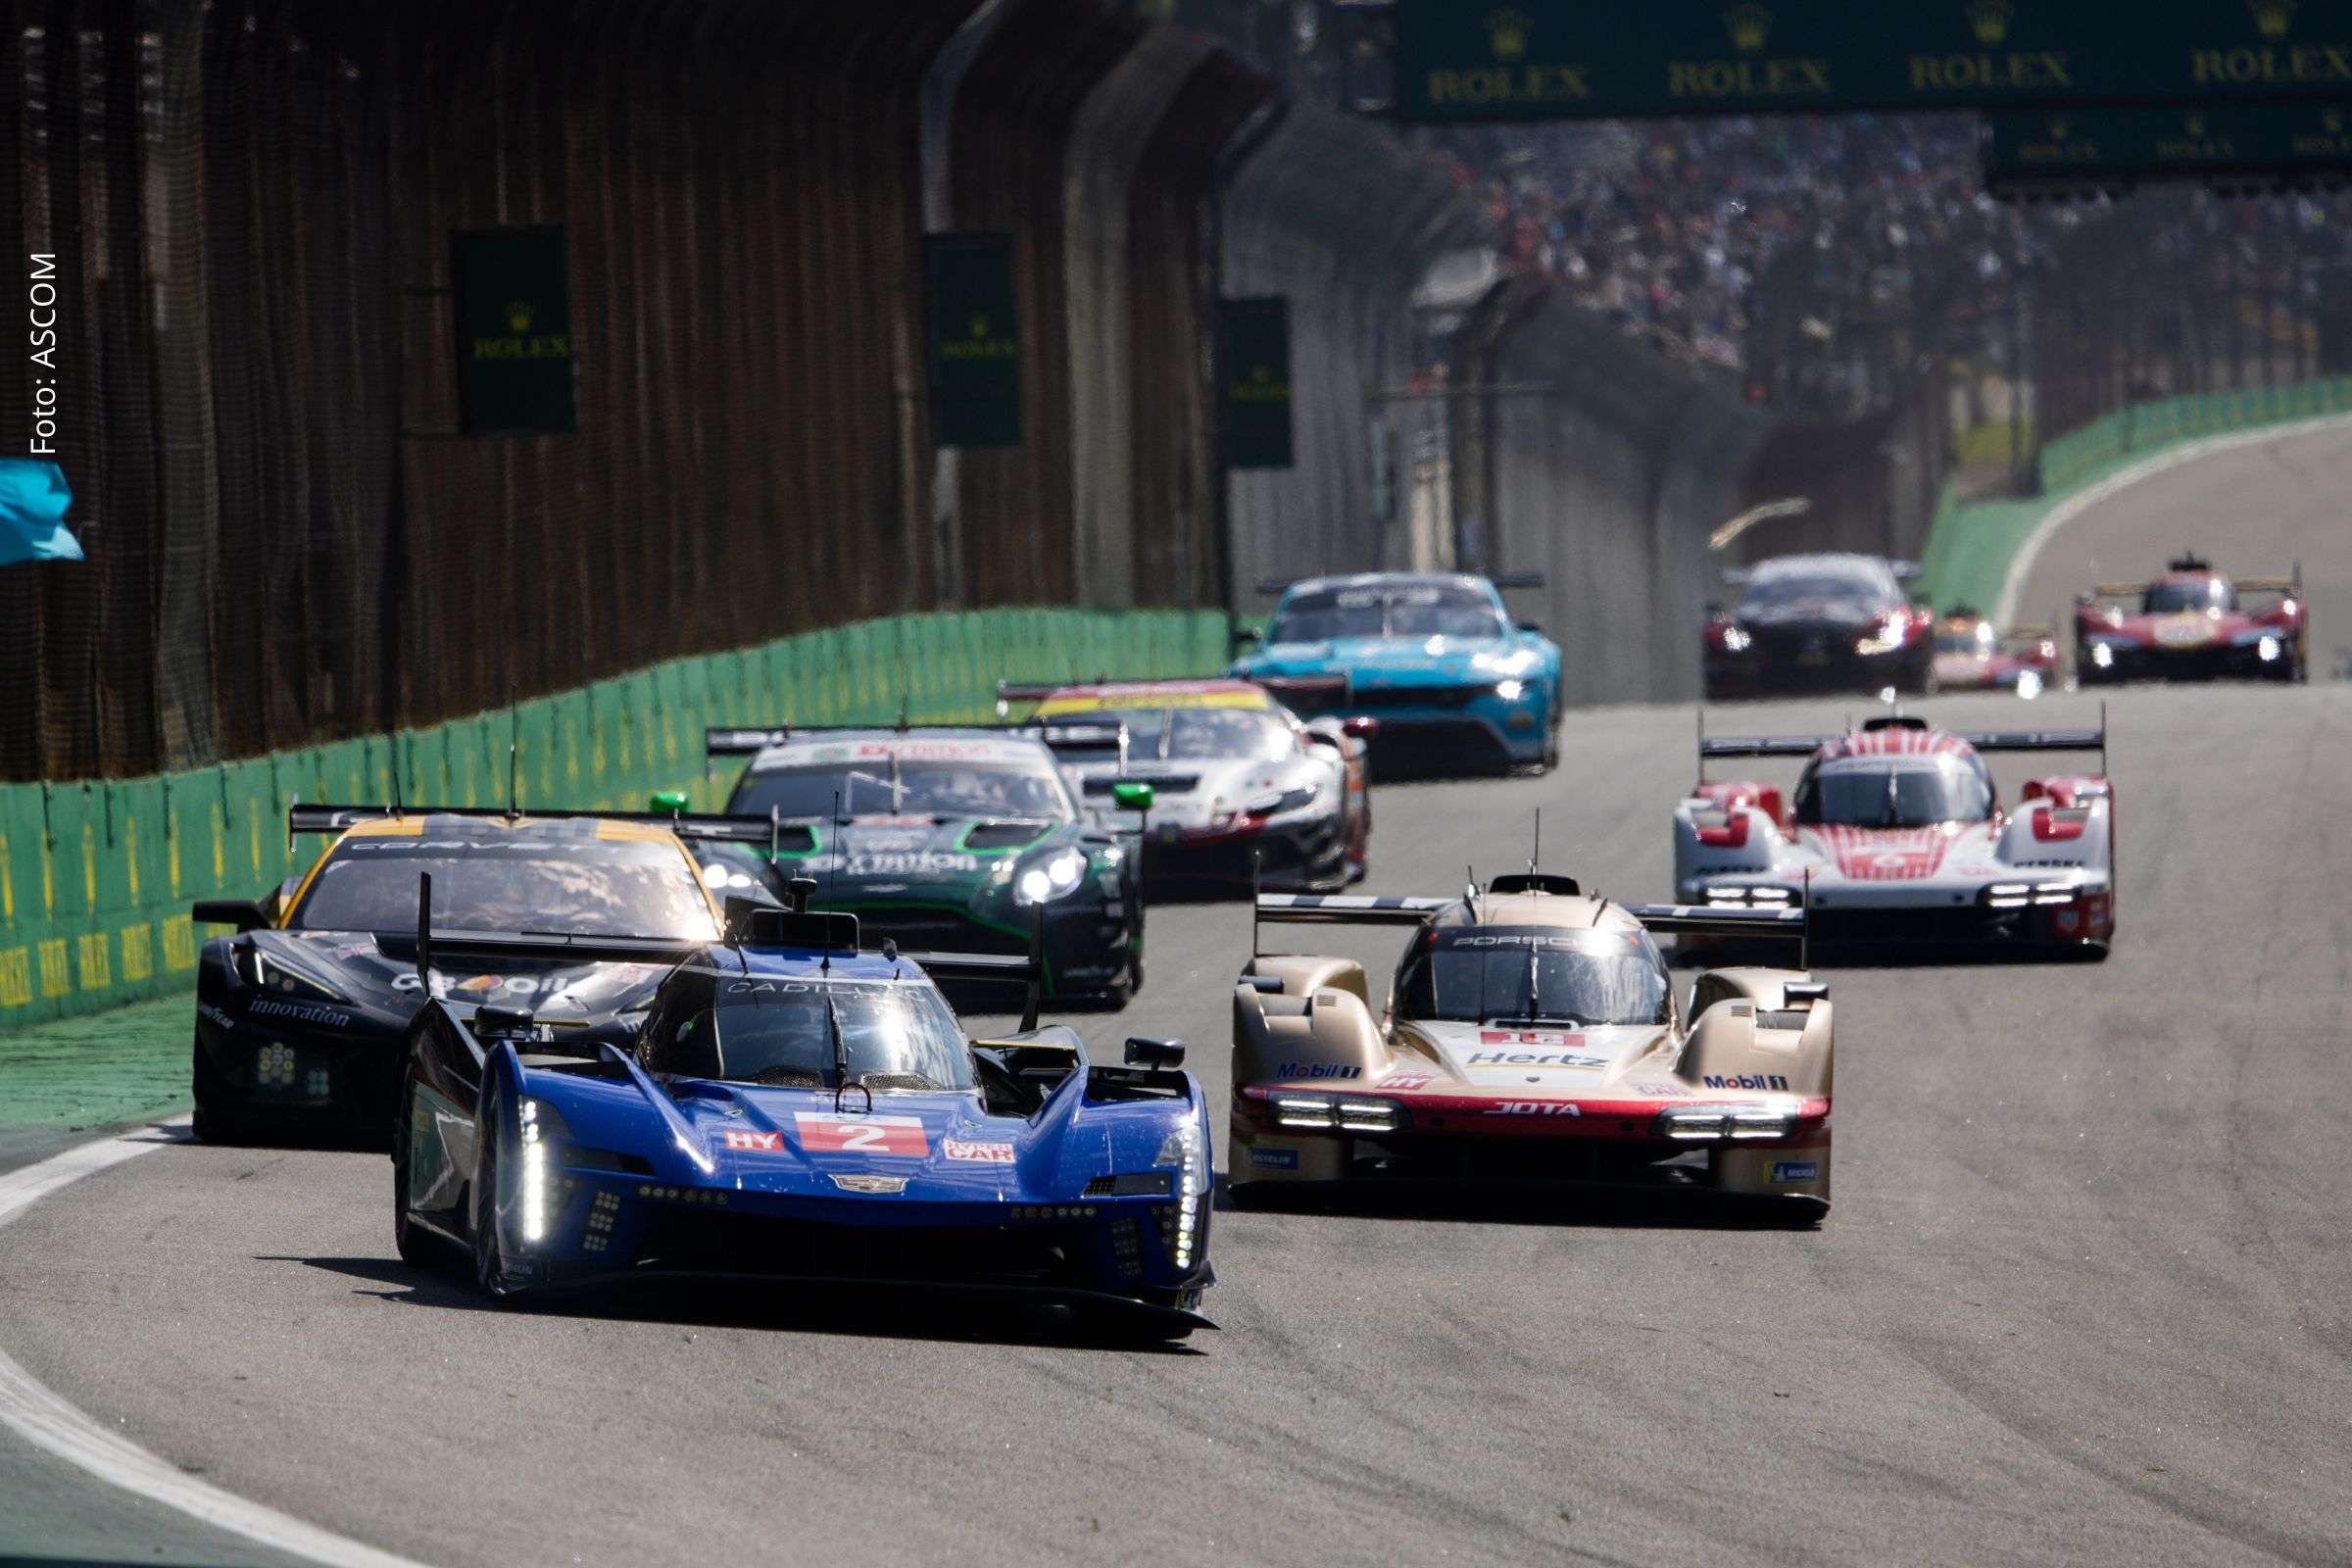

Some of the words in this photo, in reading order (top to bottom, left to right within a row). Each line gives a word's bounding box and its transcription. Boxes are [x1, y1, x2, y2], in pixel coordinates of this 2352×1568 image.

[1909, 51, 2072, 88] ROLEX
[2189, 46, 2352, 83] ROLEX
[1427, 65, 1590, 104] ROLEX
[1669, 59, 1831, 97] ROLEX
[473, 337, 568, 359] ROLEX
[249, 994, 350, 1027] innovation
[1277, 1063, 1339, 1079] Mobil
[1467, 1053, 1610, 1068] Hertz
[1703, 1075, 1766, 1090] Mobil
[1483, 1102, 1582, 1117] JOTA
[727, 1132, 779, 1150] HY
[838, 1124, 890, 1152] 2
[948, 1148, 1012, 1161] CAR
